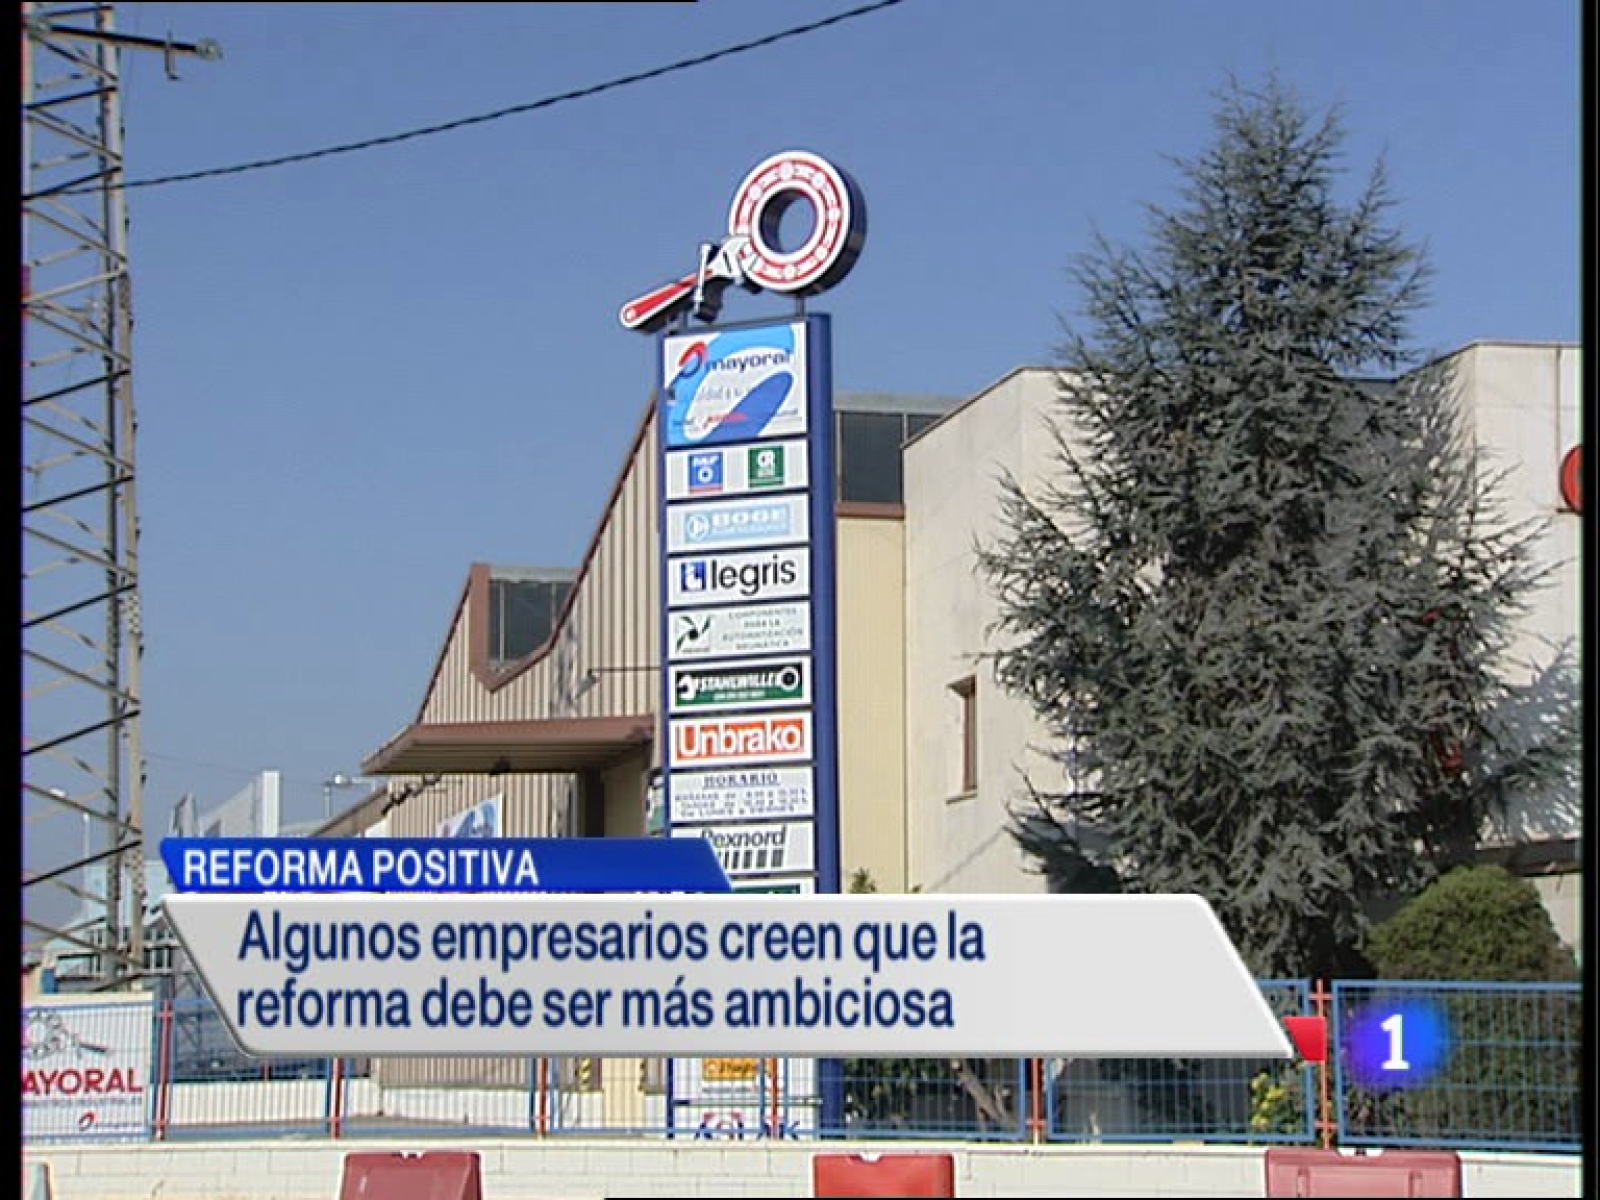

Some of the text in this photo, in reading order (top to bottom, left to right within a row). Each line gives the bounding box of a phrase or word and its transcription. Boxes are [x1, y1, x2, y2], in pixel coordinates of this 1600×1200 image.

[711, 553, 797, 597] legris
[679, 719, 800, 756] Unbrako
[703, 772, 779, 788] HORARIO
